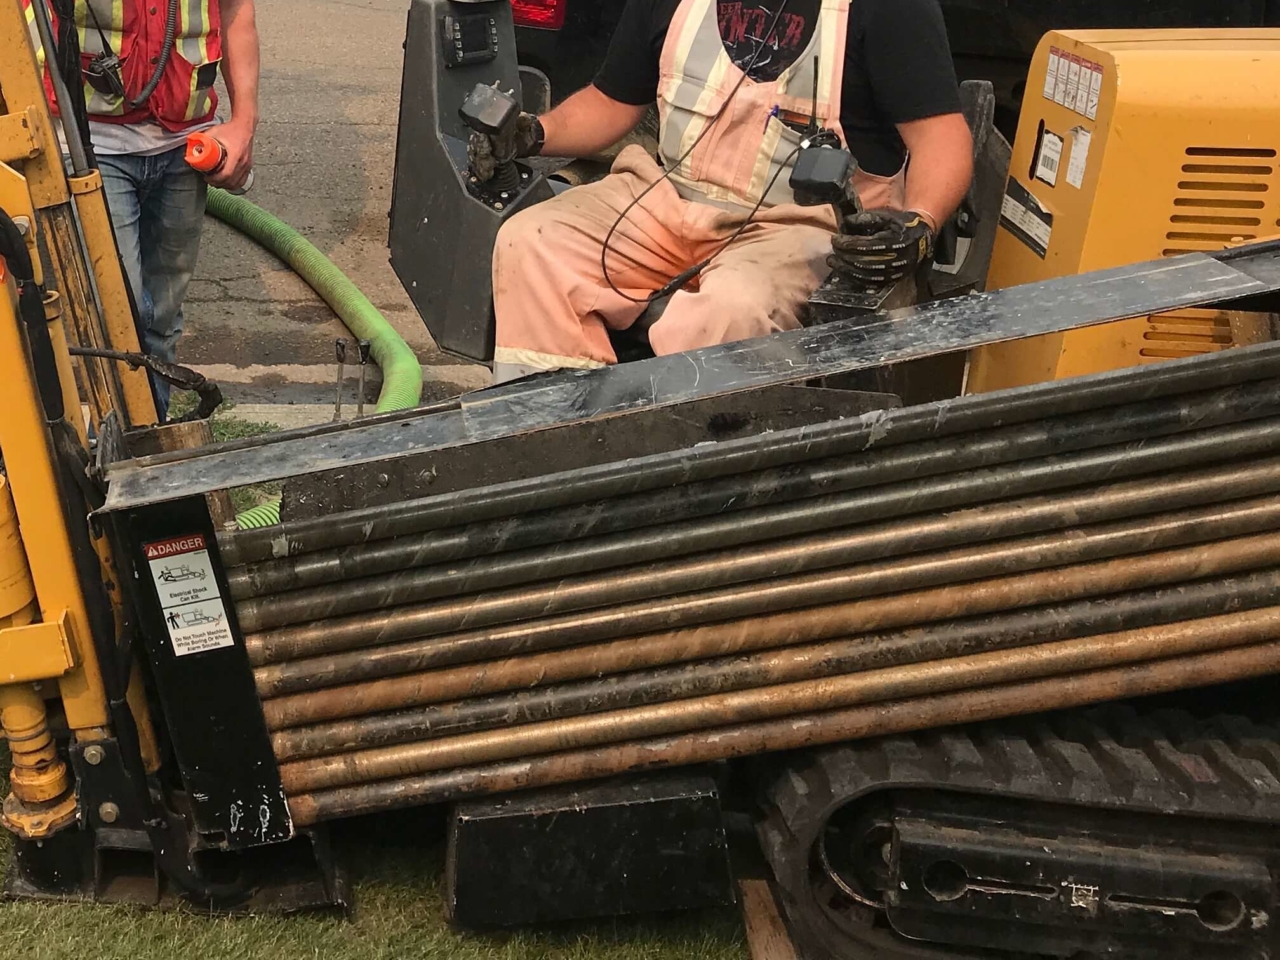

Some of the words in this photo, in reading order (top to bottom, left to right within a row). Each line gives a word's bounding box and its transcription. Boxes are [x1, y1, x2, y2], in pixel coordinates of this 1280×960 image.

[158, 538, 203, 555] DANGER
[169, 588, 192, 599] Electrical
[192, 586, 208, 595] Shock
[192, 631, 206, 639] Touch
[206, 628, 227, 637] Machine
[176, 640, 191, 648] While
[191, 637, 207, 646] Boring
[214, 633, 228, 641] When
[187, 643, 201, 652] Alarm
